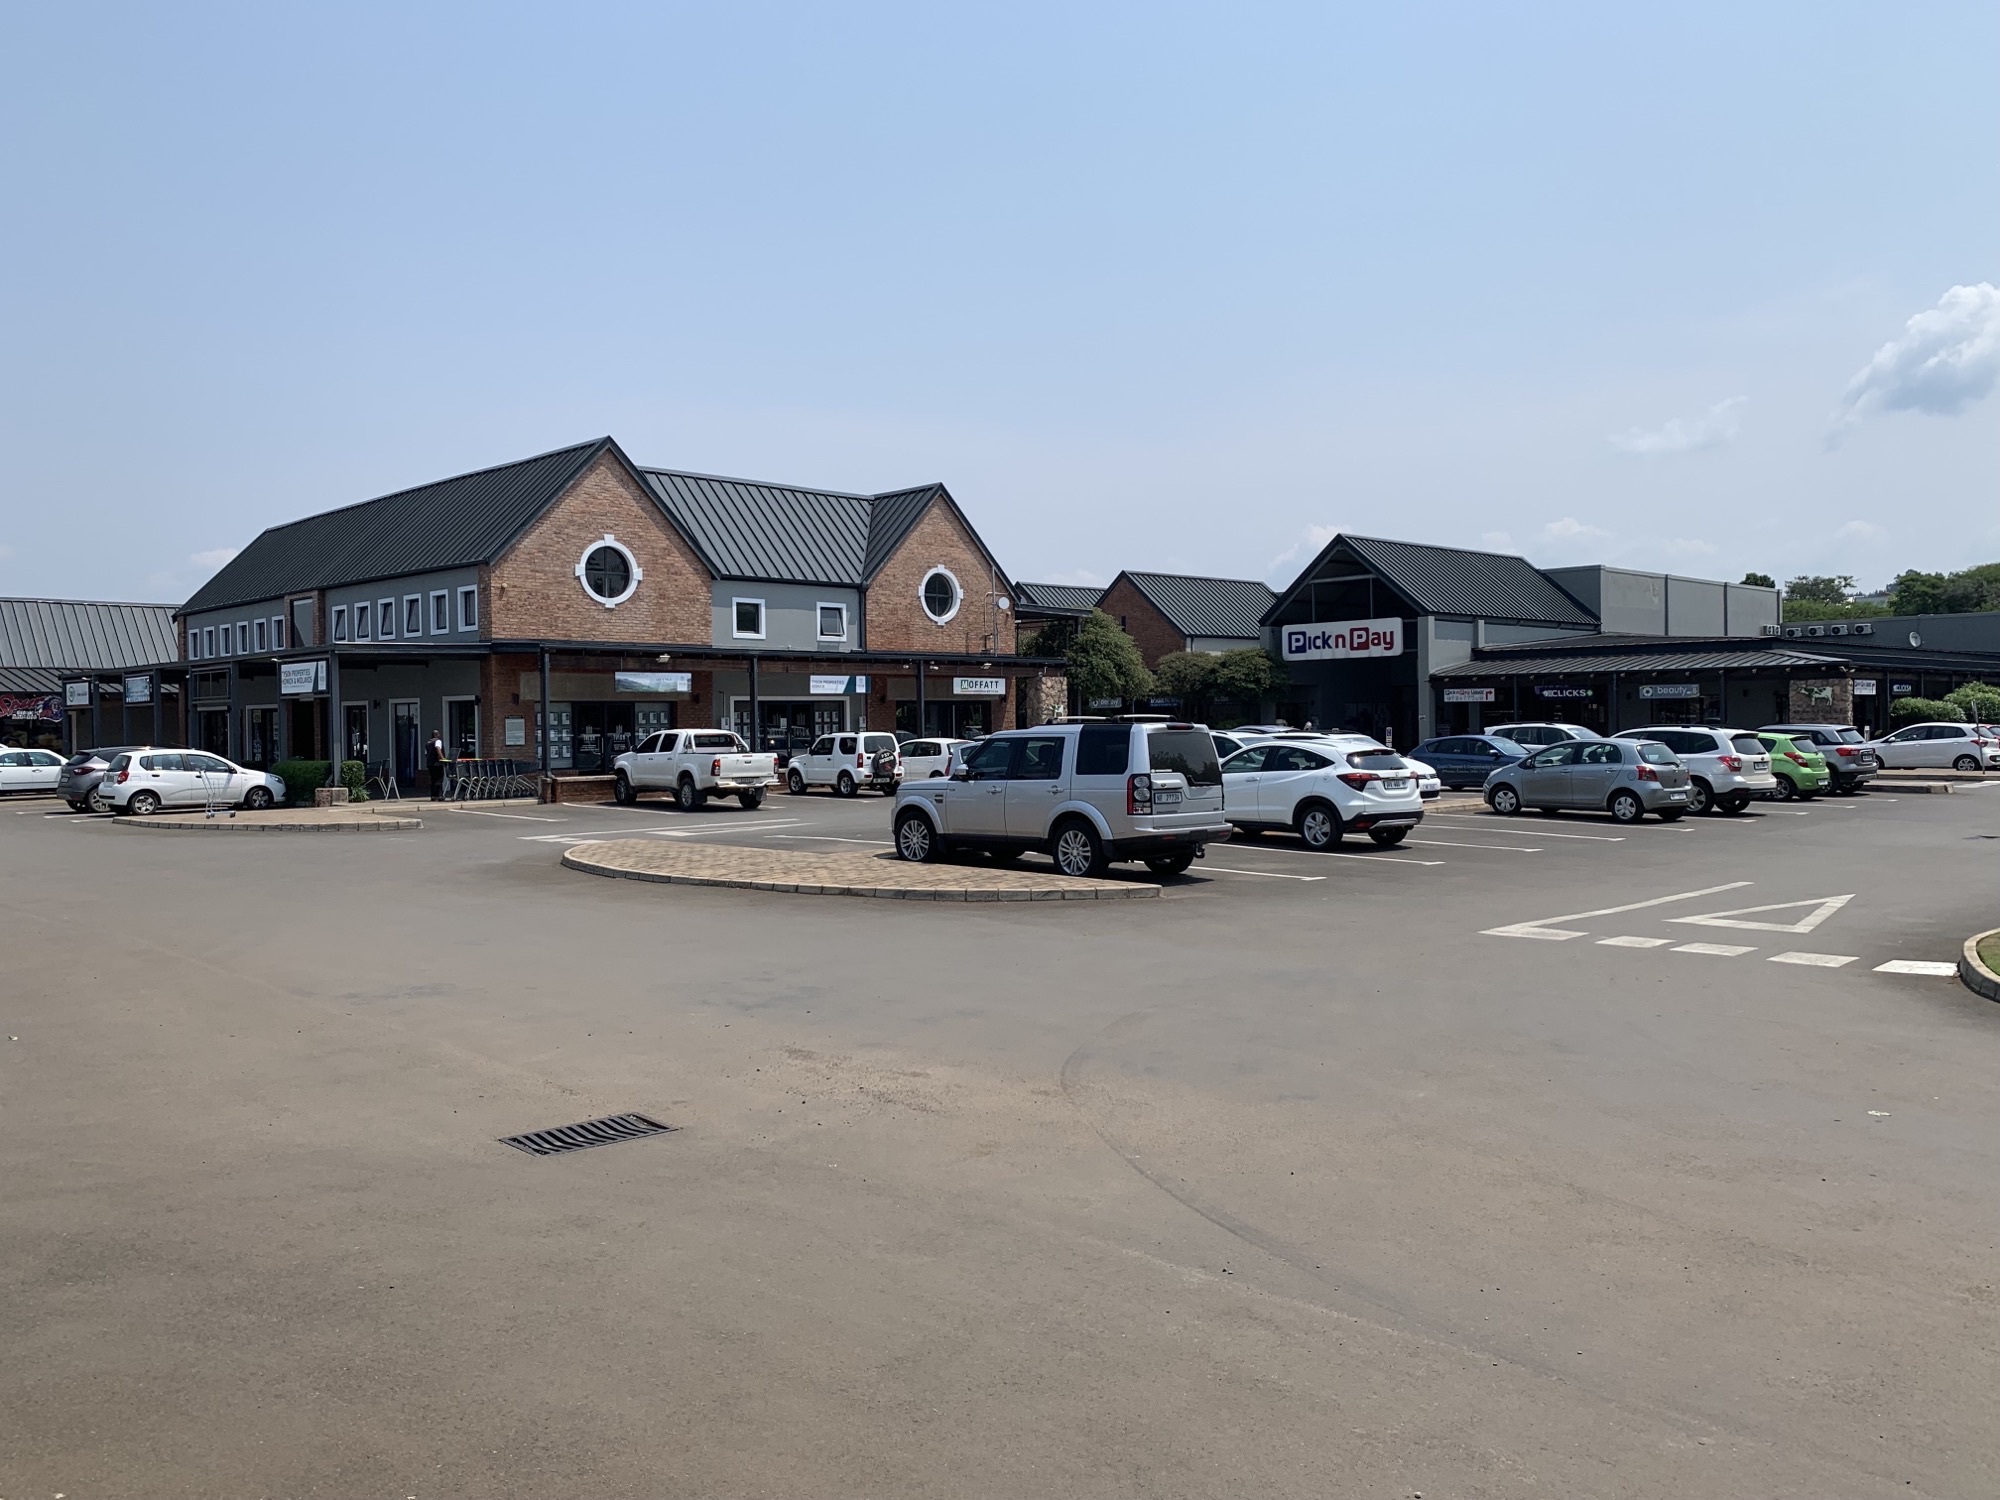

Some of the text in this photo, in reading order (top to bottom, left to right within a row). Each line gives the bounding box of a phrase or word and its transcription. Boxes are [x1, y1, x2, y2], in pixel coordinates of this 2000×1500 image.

[1288, 627, 1394, 654] Pick n Pay
[961, 680, 999, 689] MOFFATT
[1552, 689, 1586, 697] CLICKS
[1657, 686, 1687, 696] beauty
